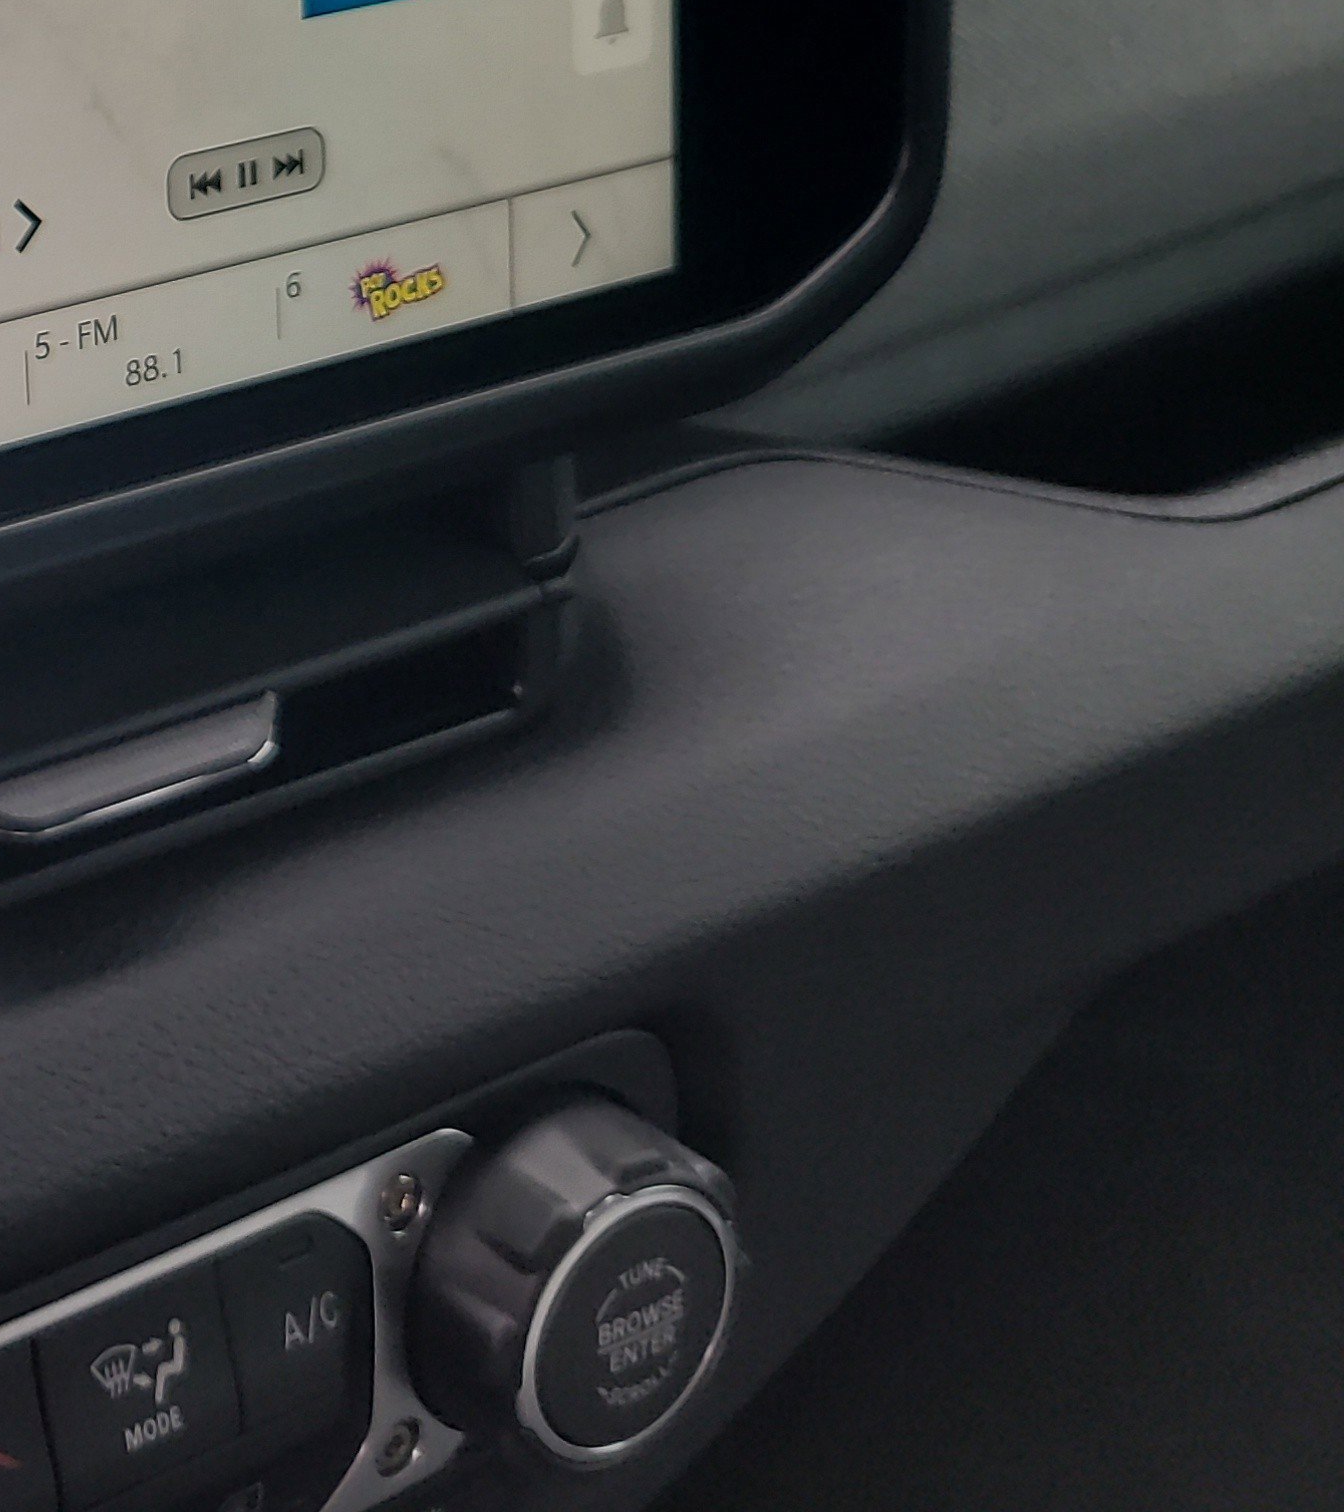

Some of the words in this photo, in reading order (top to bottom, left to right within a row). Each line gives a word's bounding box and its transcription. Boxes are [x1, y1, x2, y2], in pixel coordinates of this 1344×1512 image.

[285, 271, 302, 299] 6
[34, 331, 51, 360] 5
[77, 314, 119, 350] FM
[124, 348, 185, 387] 88.1
[285, 1291, 337, 1350] A/C
[598, 1288, 684, 1347] BROWSE
[610, 1323, 676, 1374] ENTER
[125, 1405, 184, 1454] MODE
